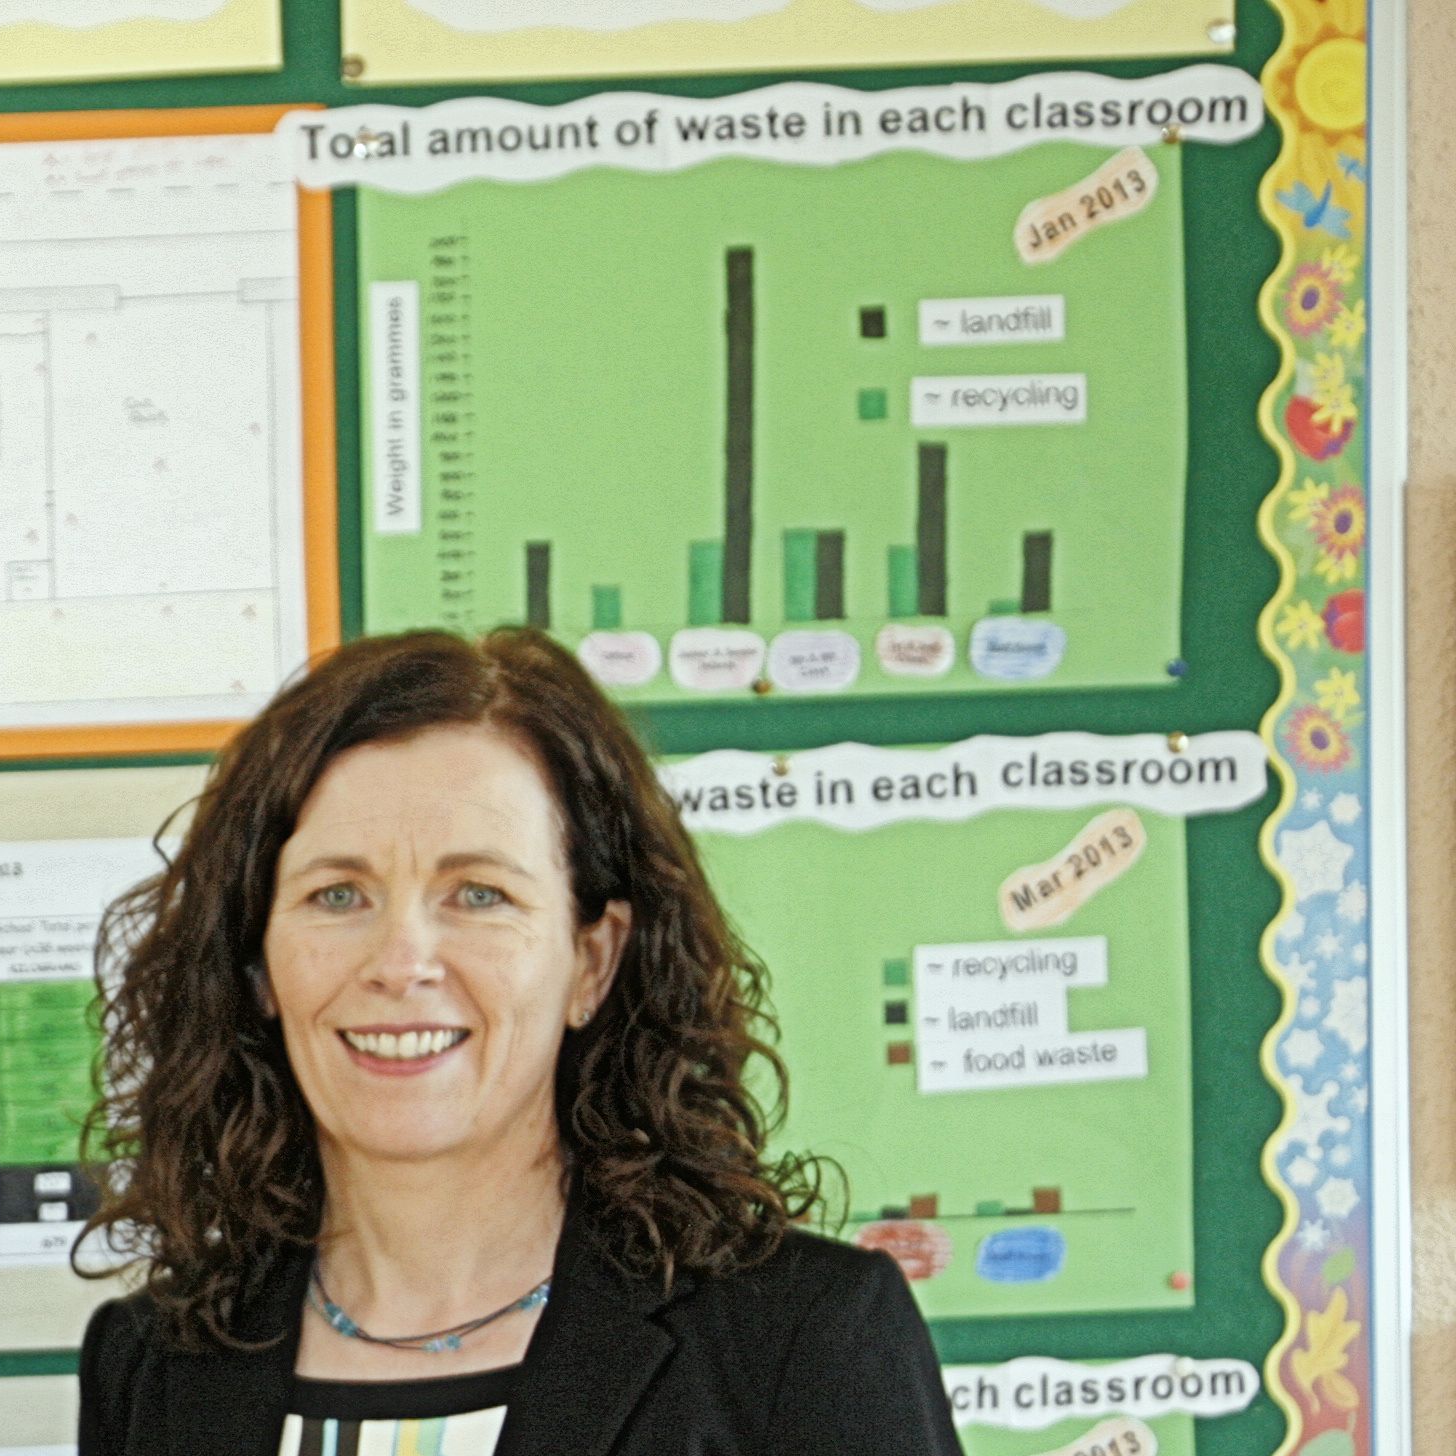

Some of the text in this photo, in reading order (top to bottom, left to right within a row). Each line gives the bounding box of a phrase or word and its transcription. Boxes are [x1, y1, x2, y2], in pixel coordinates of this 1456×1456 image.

[301, 92, 1249, 160] Toal amount of waste in each classroom
[1025, 166, 1148, 252] Jan 2013
[960, 305, 1052, 334] landfill
[951, 380, 1079, 412] recycling
[677, 752, 1239, 812] waste in each classroom
[1008, 823, 1135, 914] Mar 2013
[951, 948, 1078, 982] recycling
[948, 1000, 1039, 1031] landfill
[962, 1039, 1118, 1073] food waste
[1013, 1369, 1247, 1409] classroom
